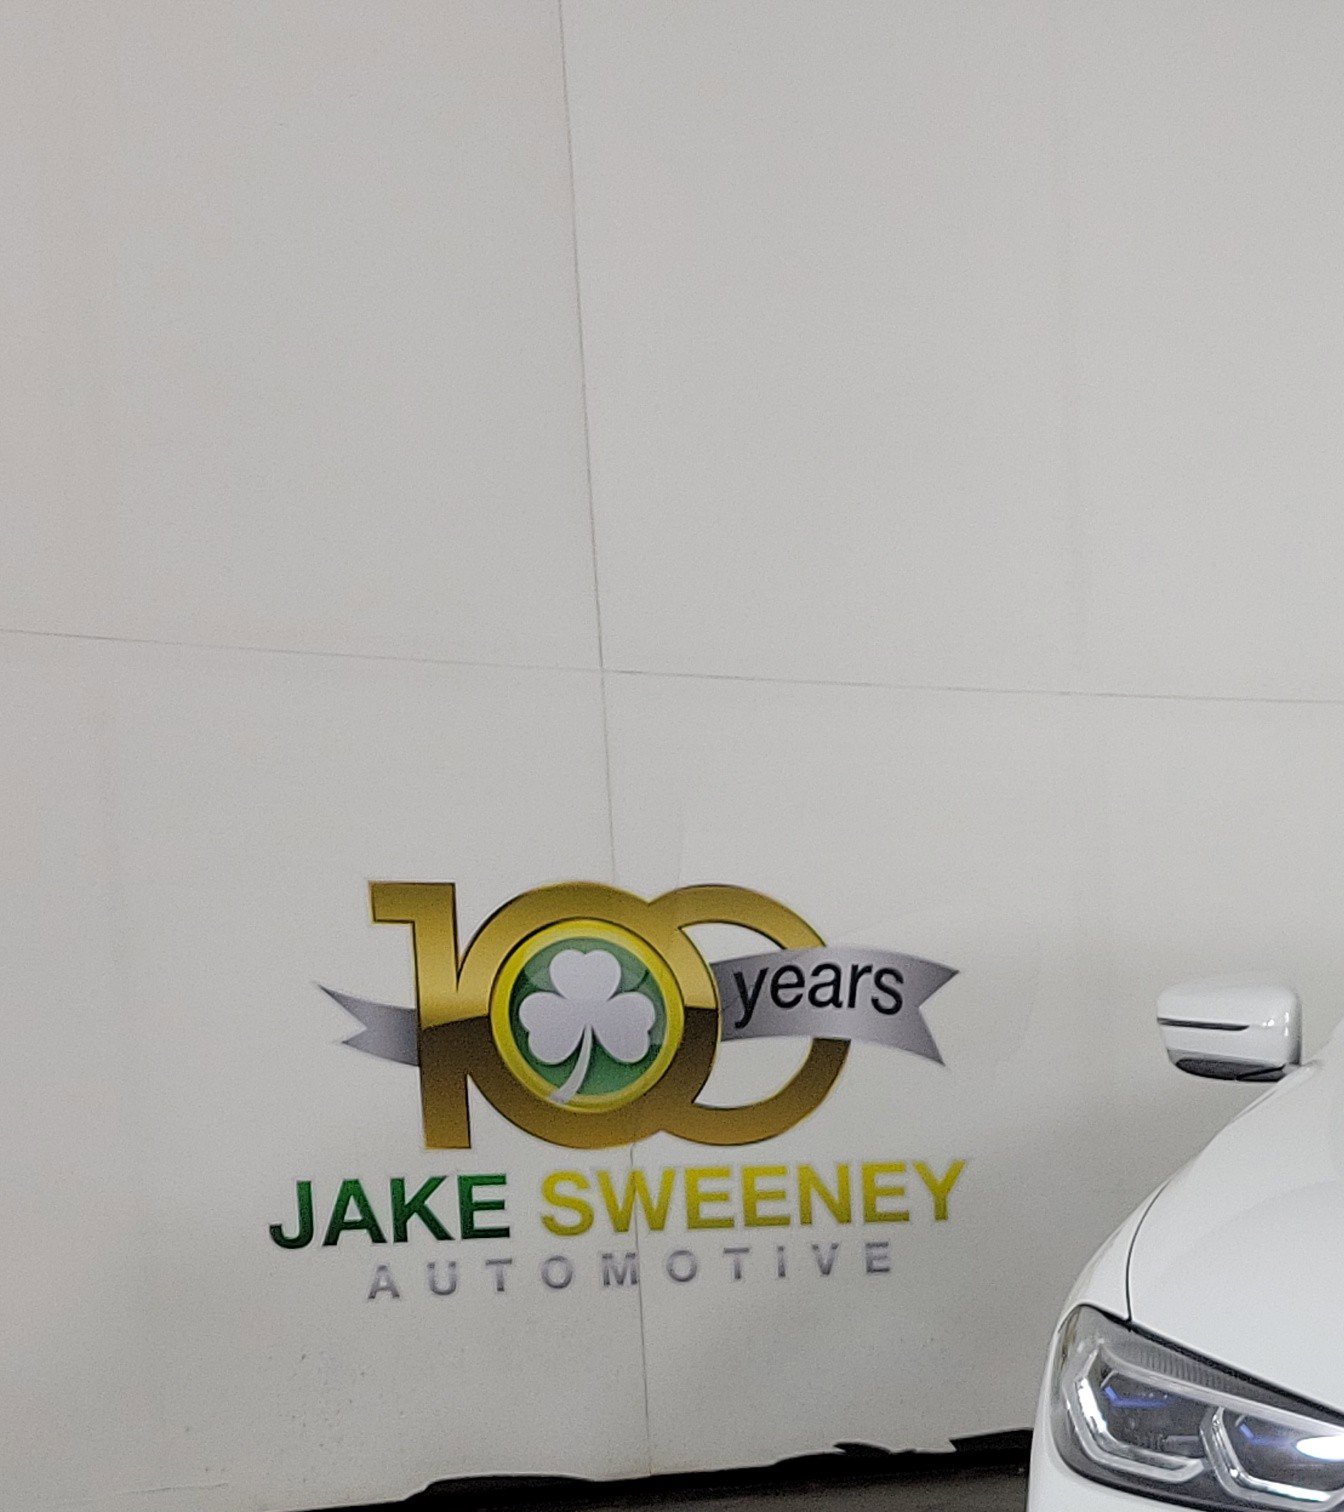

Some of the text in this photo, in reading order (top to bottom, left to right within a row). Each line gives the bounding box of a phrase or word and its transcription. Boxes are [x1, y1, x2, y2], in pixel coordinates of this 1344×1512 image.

[368, 881, 905, 1150] 100 years
[268, 1159, 967, 1250] JAKE SWEENEY
[367, 1241, 893, 1301] AUTOMOTIVE
